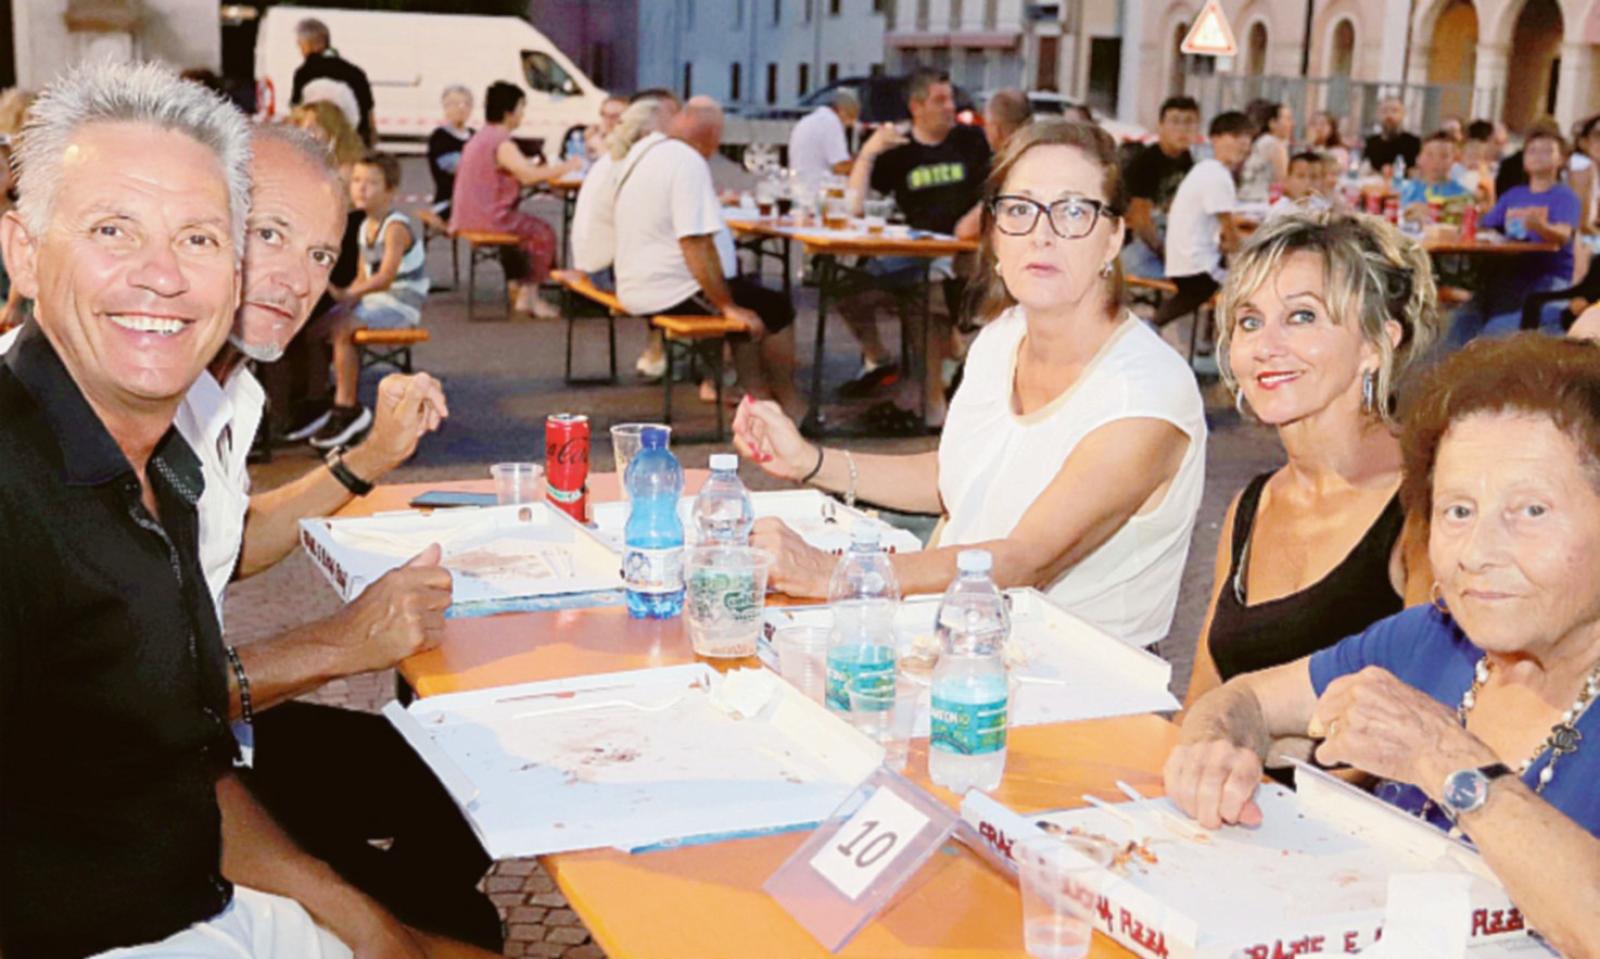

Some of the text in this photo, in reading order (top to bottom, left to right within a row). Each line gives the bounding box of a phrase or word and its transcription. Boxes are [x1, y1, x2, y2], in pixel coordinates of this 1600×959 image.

[837, 820, 898, 868] 10
[1343, 930, 1362, 954] E
[1471, 908, 1525, 937] PIZZ
